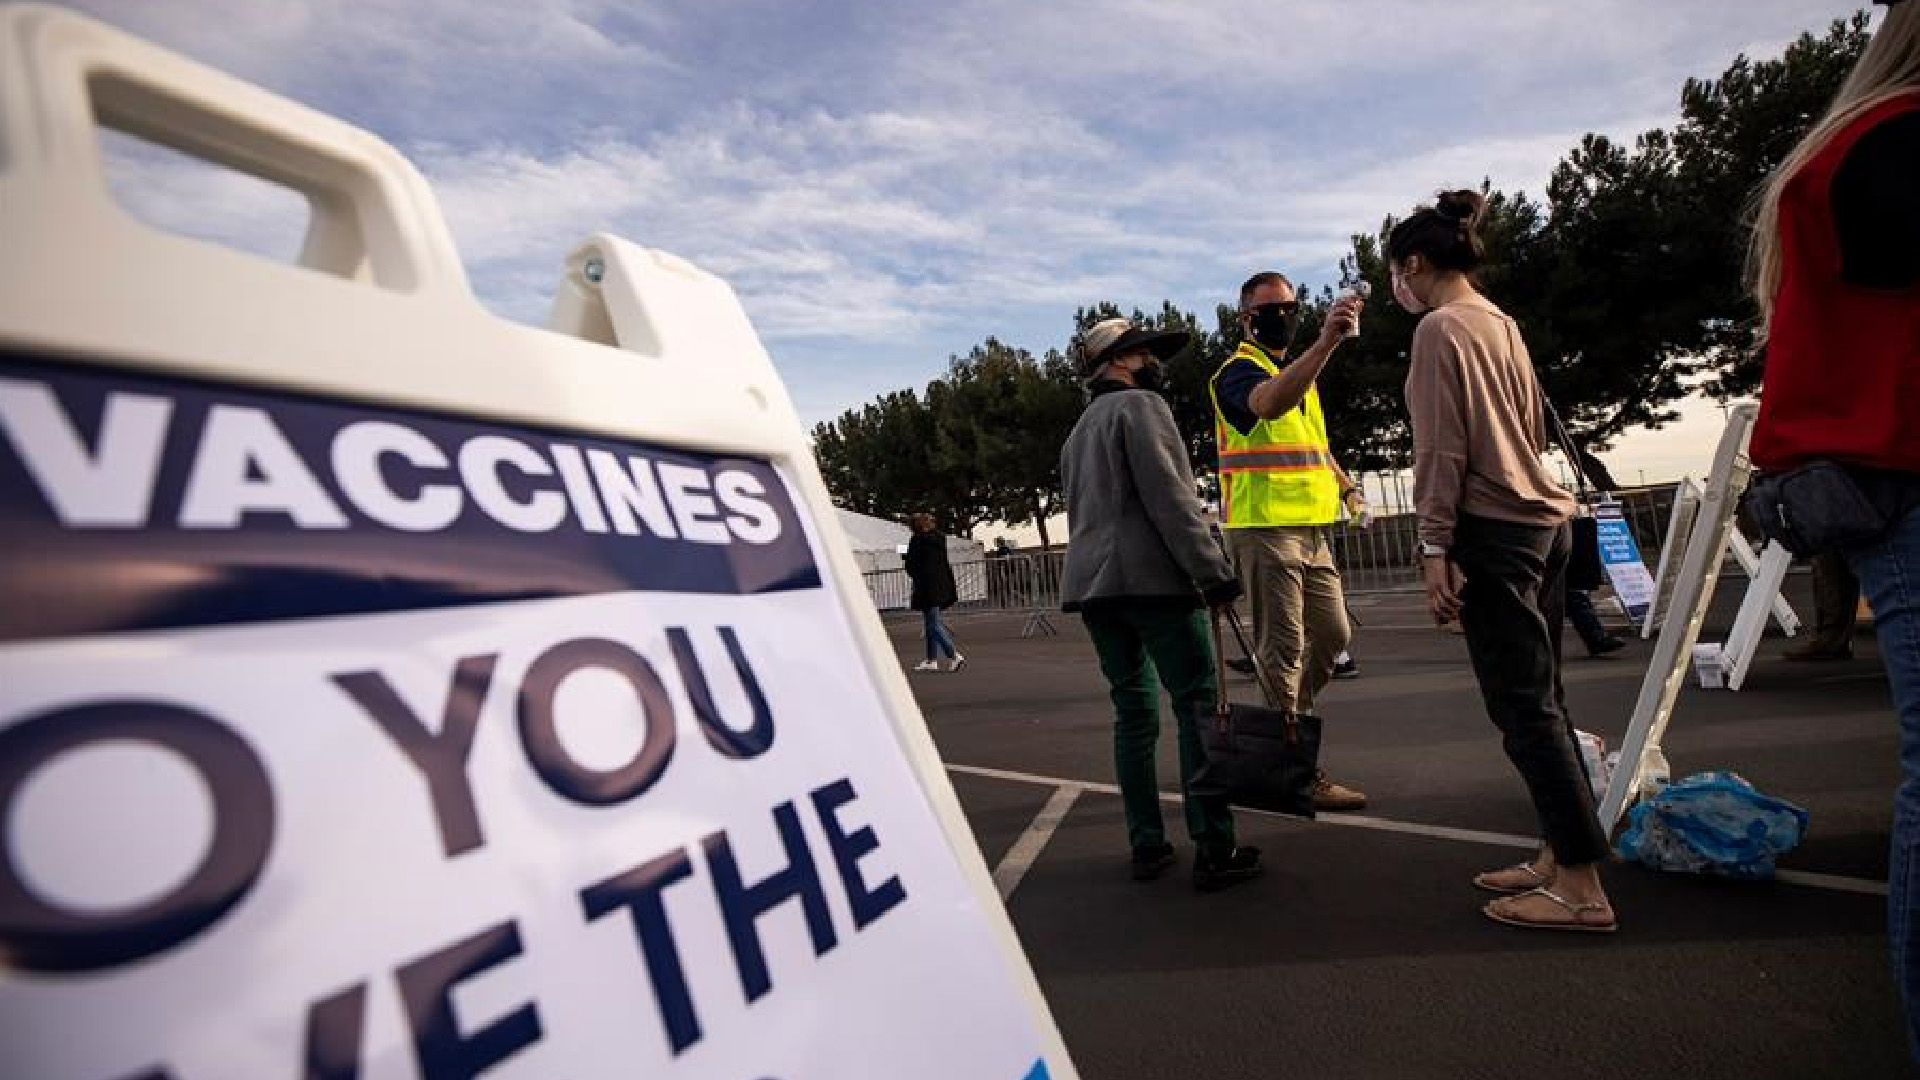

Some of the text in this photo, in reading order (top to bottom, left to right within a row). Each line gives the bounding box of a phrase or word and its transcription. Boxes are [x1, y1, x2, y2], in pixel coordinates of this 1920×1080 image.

[0, 380, 782, 544] VACCINES
[328, 625, 775, 859] YOU
[579, 777, 907, 1057] THE
